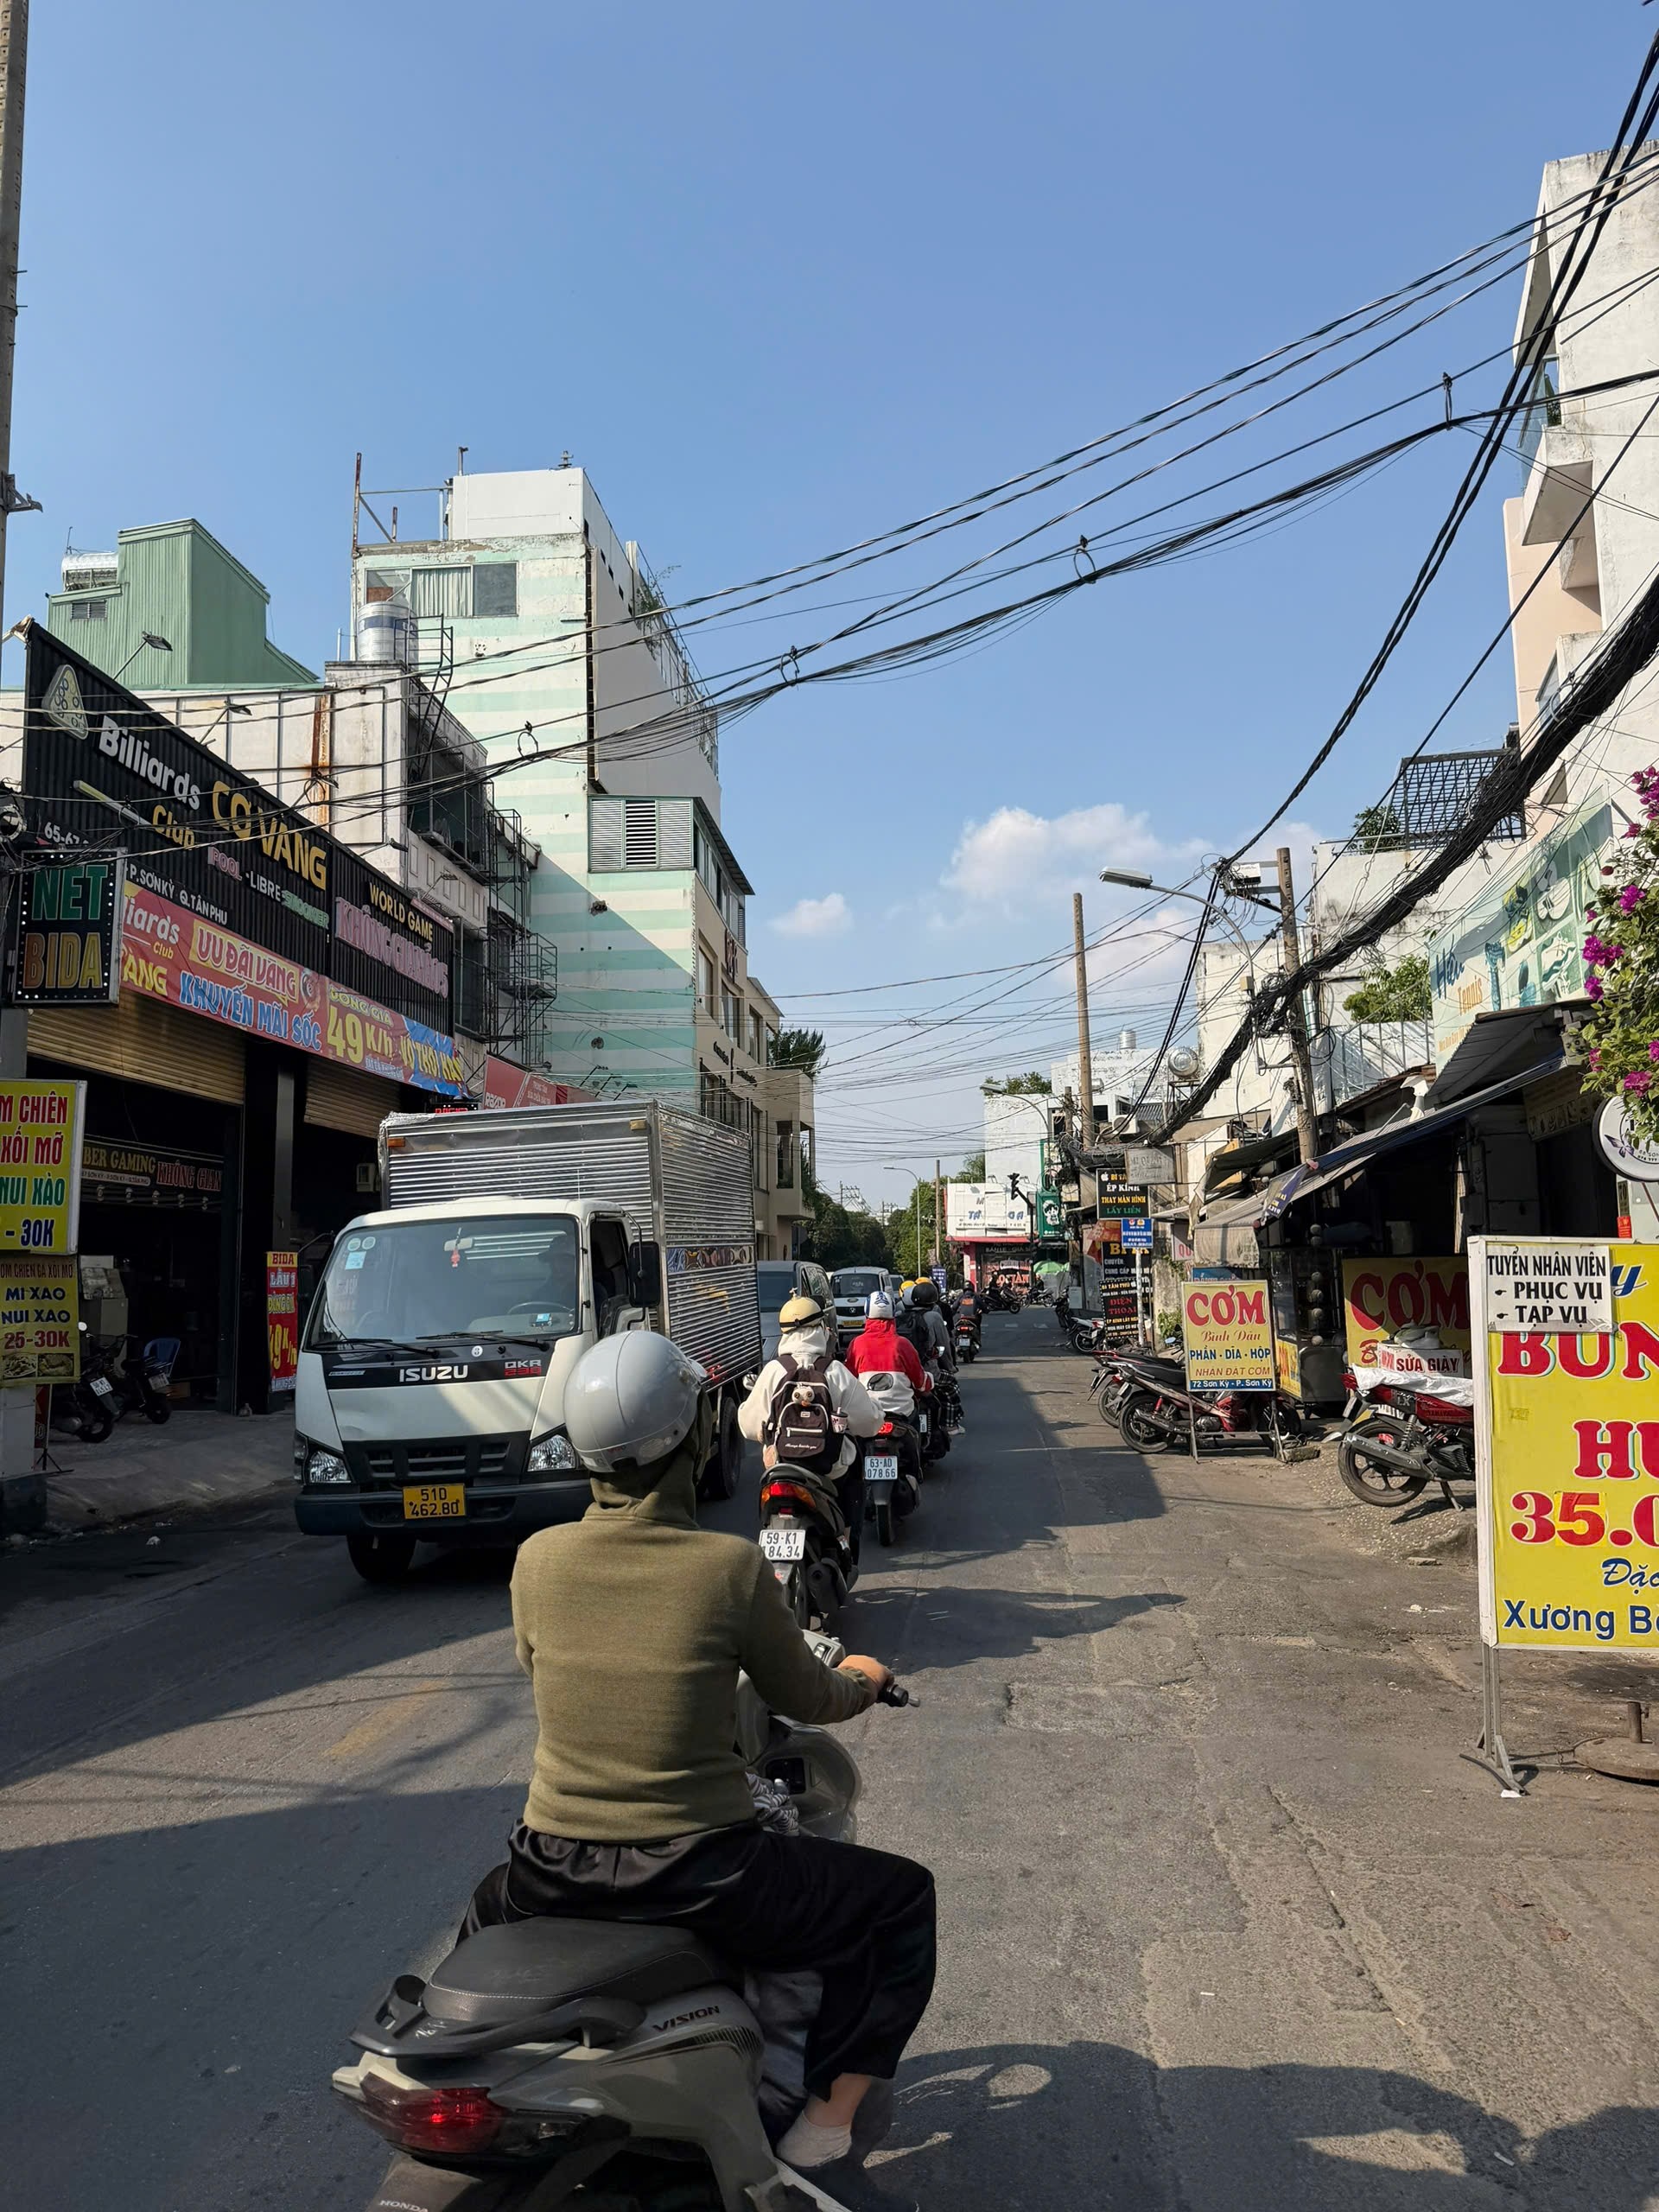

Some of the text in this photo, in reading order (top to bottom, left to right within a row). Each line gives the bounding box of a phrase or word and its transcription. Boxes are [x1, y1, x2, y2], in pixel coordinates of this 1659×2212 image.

[99, 715, 200, 810] Billiards
[152, 804, 194, 849] Club
[208, 847, 243, 881] POOL
[250, 870, 282, 901] LIBRE
[32, 865, 109, 920] NET
[369, 882, 433, 942] WORLD GAME
[22, 932, 103, 988] BIDA
[179, 970, 321, 1051] KHUYẾN MÃI SỐC
[1458, 975, 1483, 1016] Tennis
[327, 1005, 363, 1065] 49
[19, 1090, 68, 1124] CHIÊN
[1, 1126, 64, 1166] XỐI MỠ
[110, 1150, 156, 1174] GAMING
[32, 1173, 66, 1206] XÀO
[21, 1219, 54, 1247] 30K
[272, 1253, 295, 1265] BIDA
[1487, 1246, 1606, 1277] TUYỂN NHÂN VIÊN
[1187, 1285, 1267, 1325] CƠM
[1351, 1259, 1471, 1331] CƠM
[1514, 1281, 1603, 1304] PHỤC VỤ
[1515, 1306, 1587, 1328] TẠP VỤ
[4, 1330, 70, 1350] 25-30K
[1190, 1345, 1217, 1360] PHẦN
[1251, 1345, 1270, 1363] HỘP
[399, 1365, 468, 1382] ISUZU
[505, 1359, 541, 1369] QKR
[1396, 1354, 1424, 1372] SỬA
[1427, 1355, 1459, 1372] GIÀY
[1219, 1379, 1229, 1389] Kỳ
[1262, 1378, 1272, 1389] Kỳ
[867, 1468, 896, 1478] 078.66
[410, 1502, 459, 1516] 462.80
[1503, 1599, 1615, 1640] Xương
[652, 2005, 720, 2032] VISION
[378, 2200, 429, 2212] HONDA
